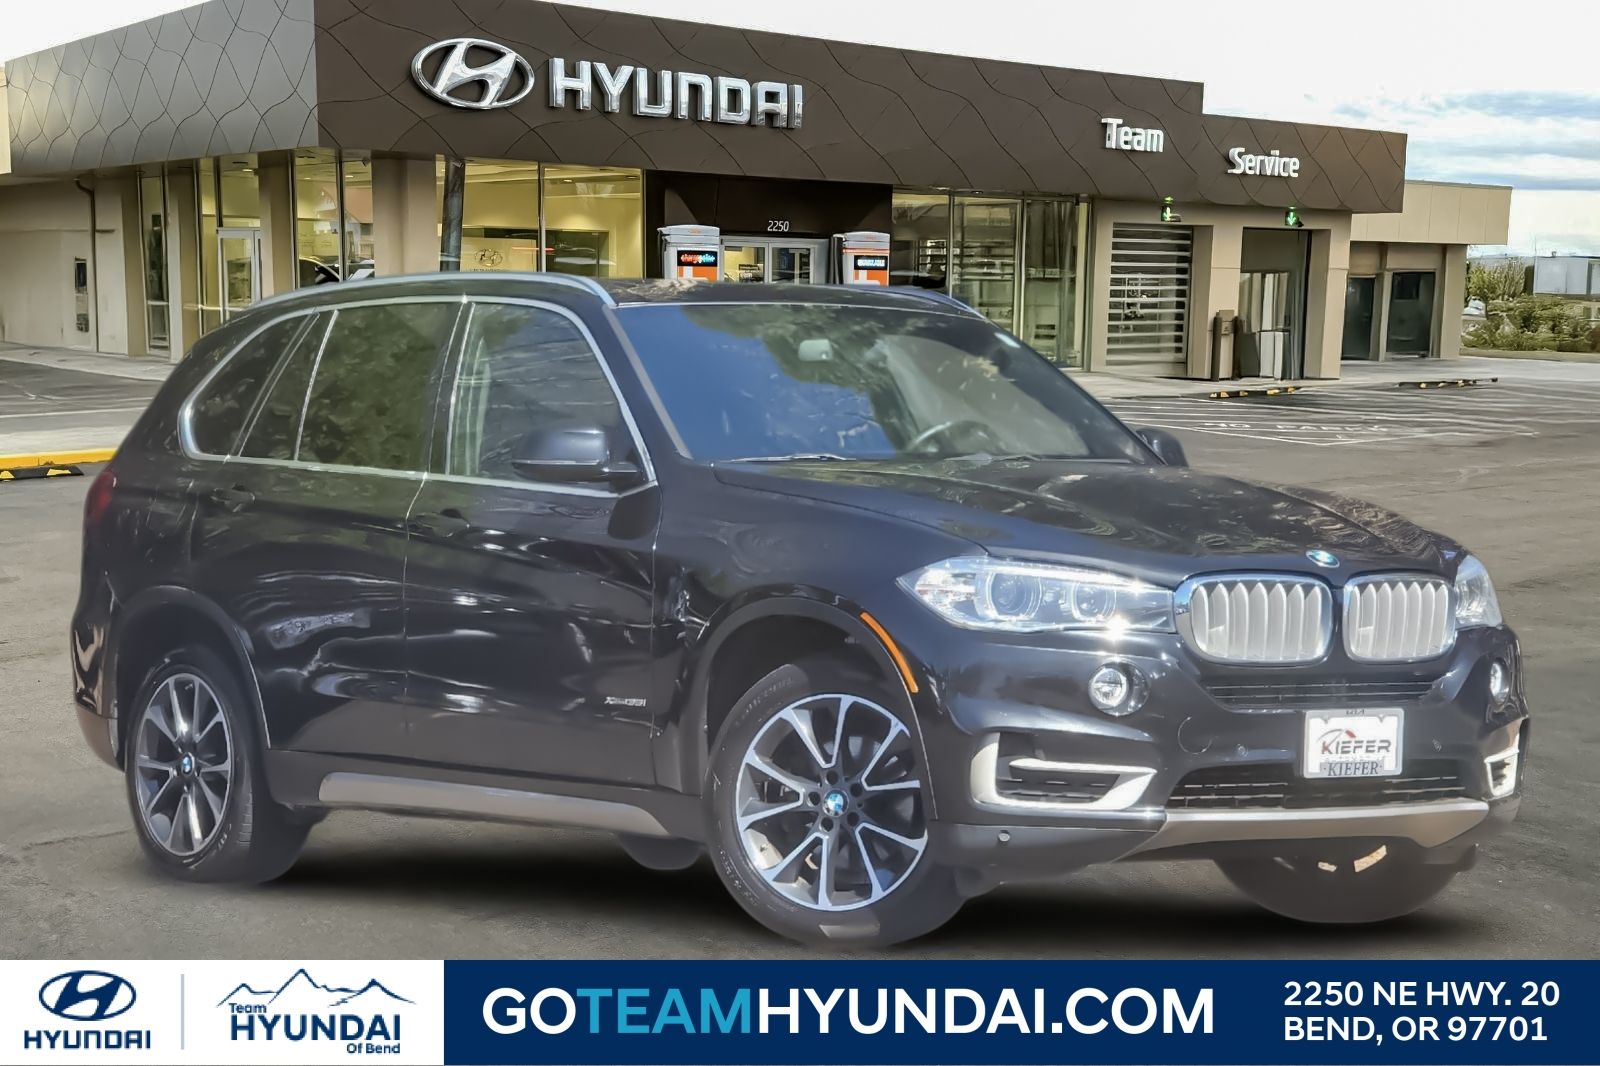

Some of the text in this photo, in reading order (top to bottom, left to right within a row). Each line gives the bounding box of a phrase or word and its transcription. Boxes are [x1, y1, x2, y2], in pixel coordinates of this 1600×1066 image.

[549, 57, 803, 129] HYUNDAI
[1101, 117, 1164, 153] Team
[1227, 147, 1300, 178] Service
[767, 219, 790, 233] 2250
[1321, 739, 1392, 755] KIEFER
[1328, 761, 1379, 777] KIEFER
